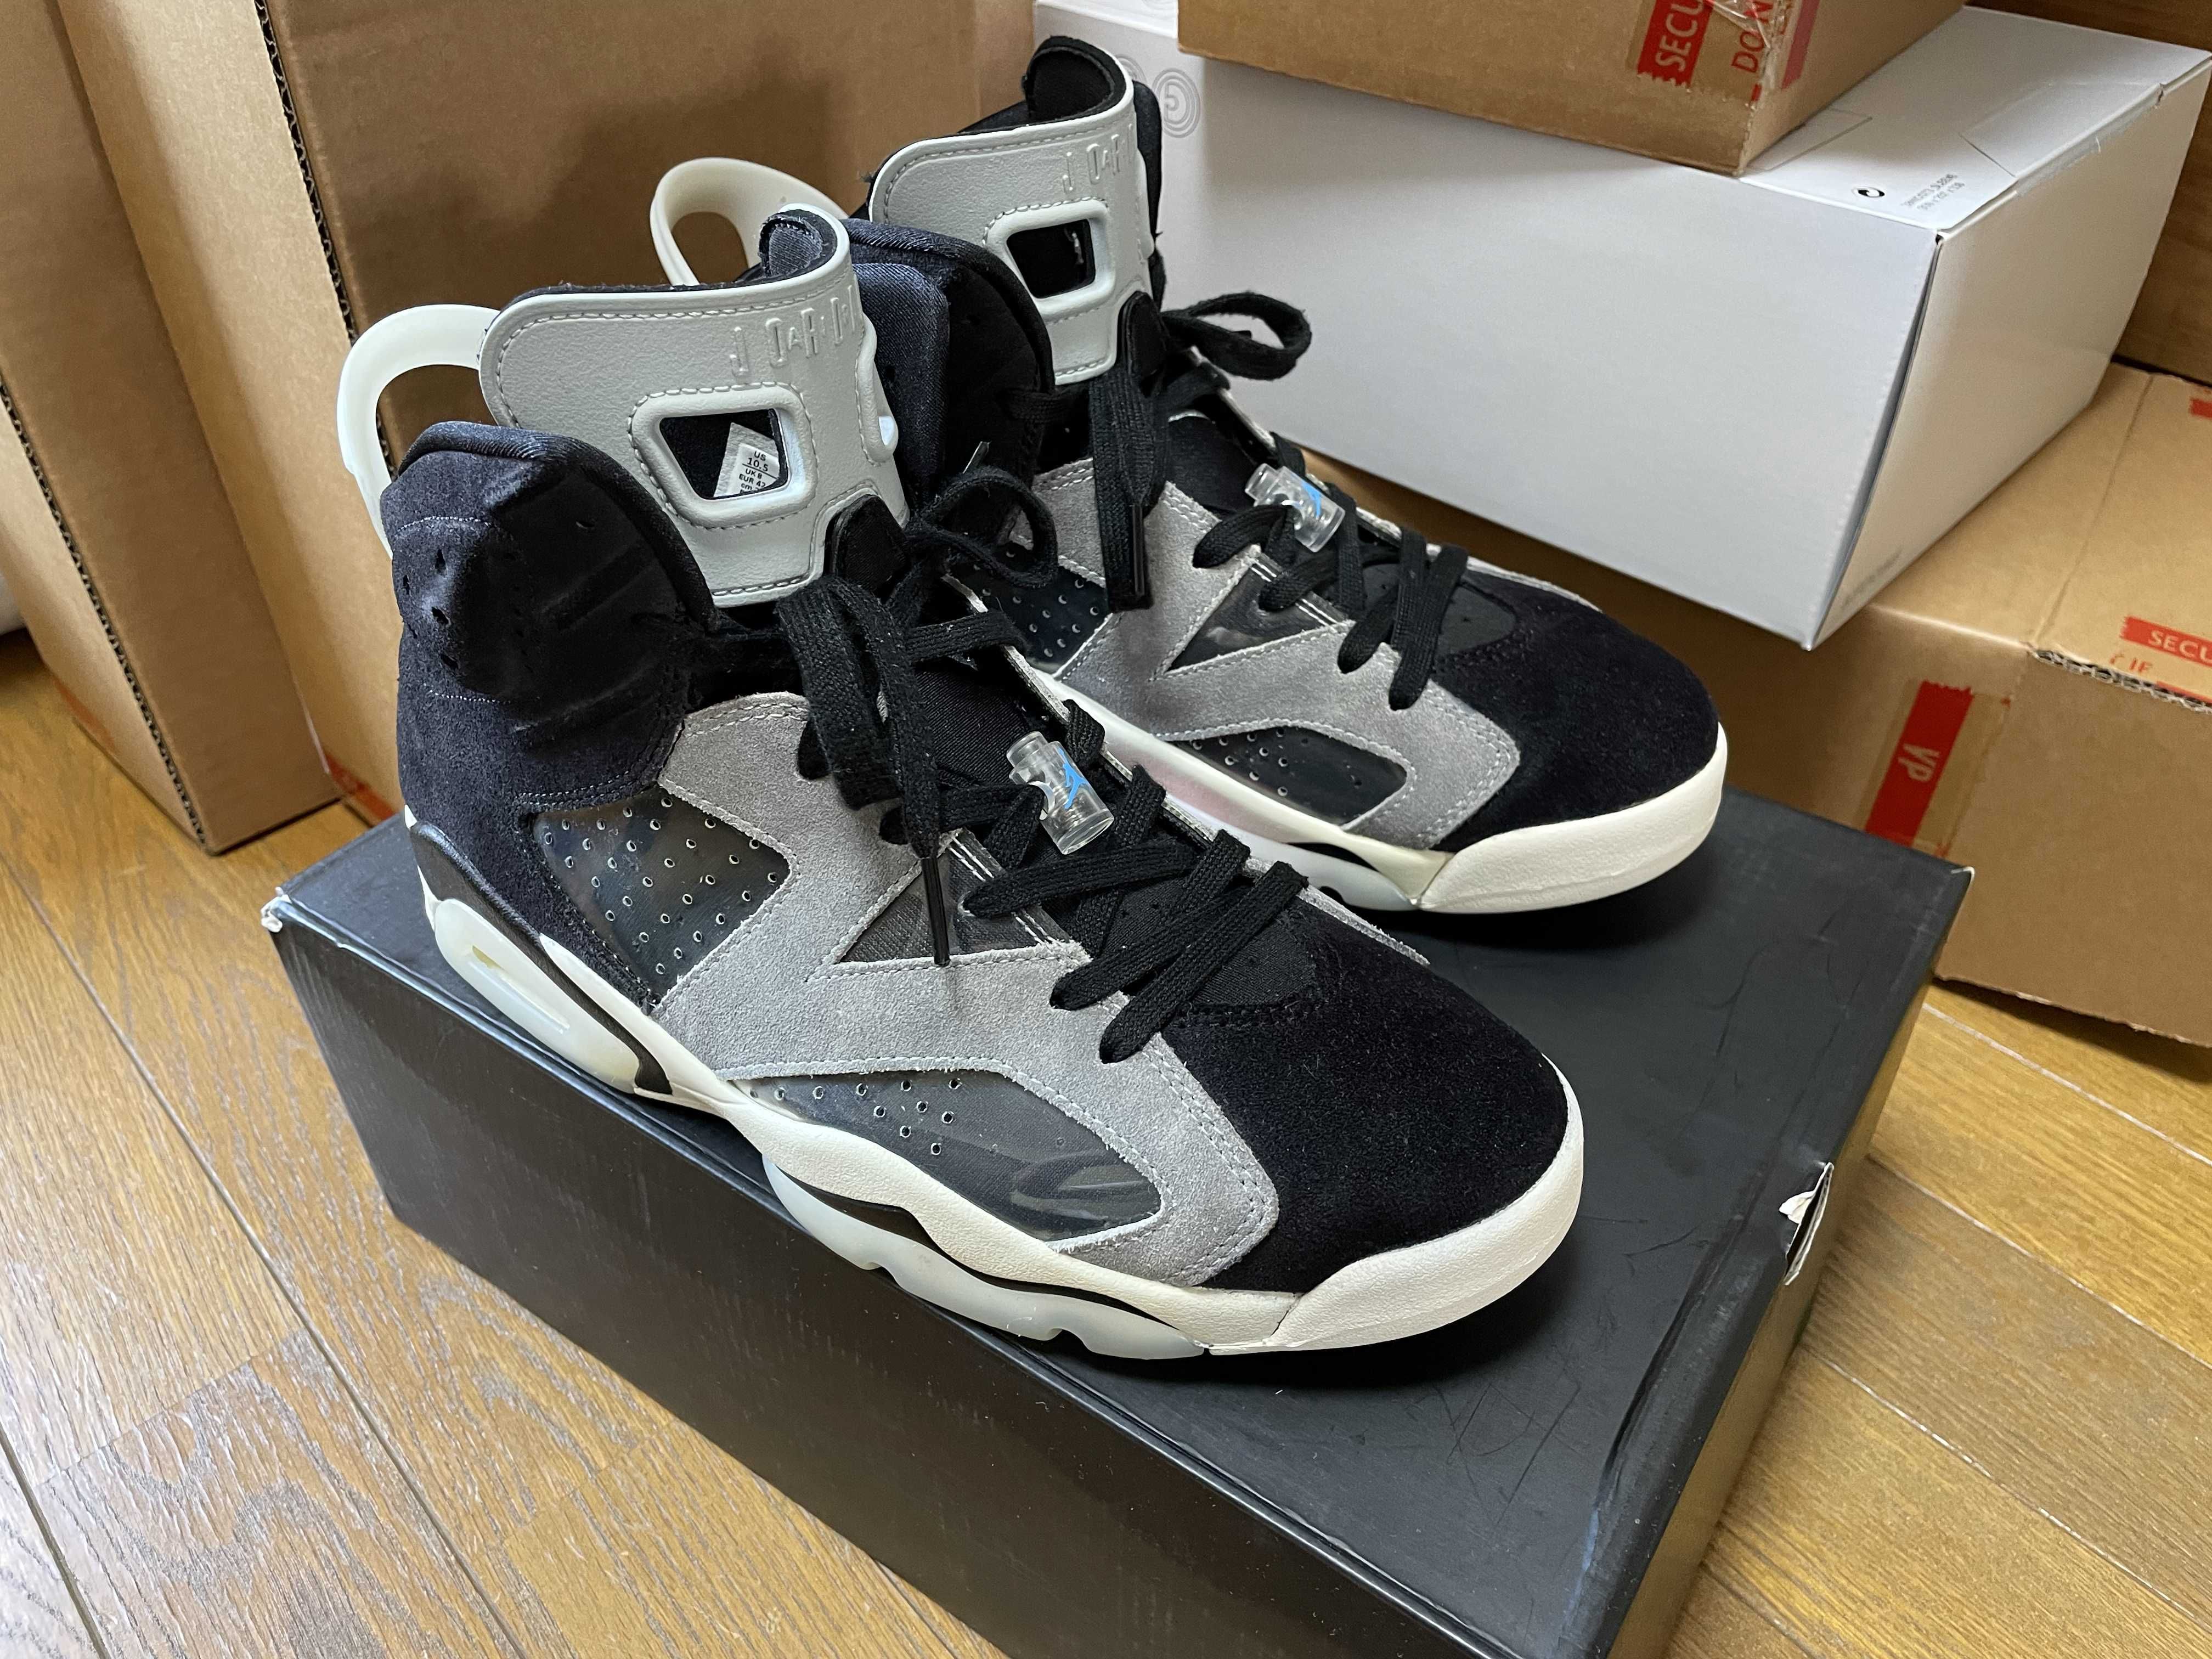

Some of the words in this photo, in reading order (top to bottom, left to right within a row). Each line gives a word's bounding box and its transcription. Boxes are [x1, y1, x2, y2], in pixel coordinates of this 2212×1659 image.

[754, 450, 766, 461] US
[747, 457, 769, 472] 10.5
[745, 468, 757, 477] UK
[738, 473, 755, 485] EUR
